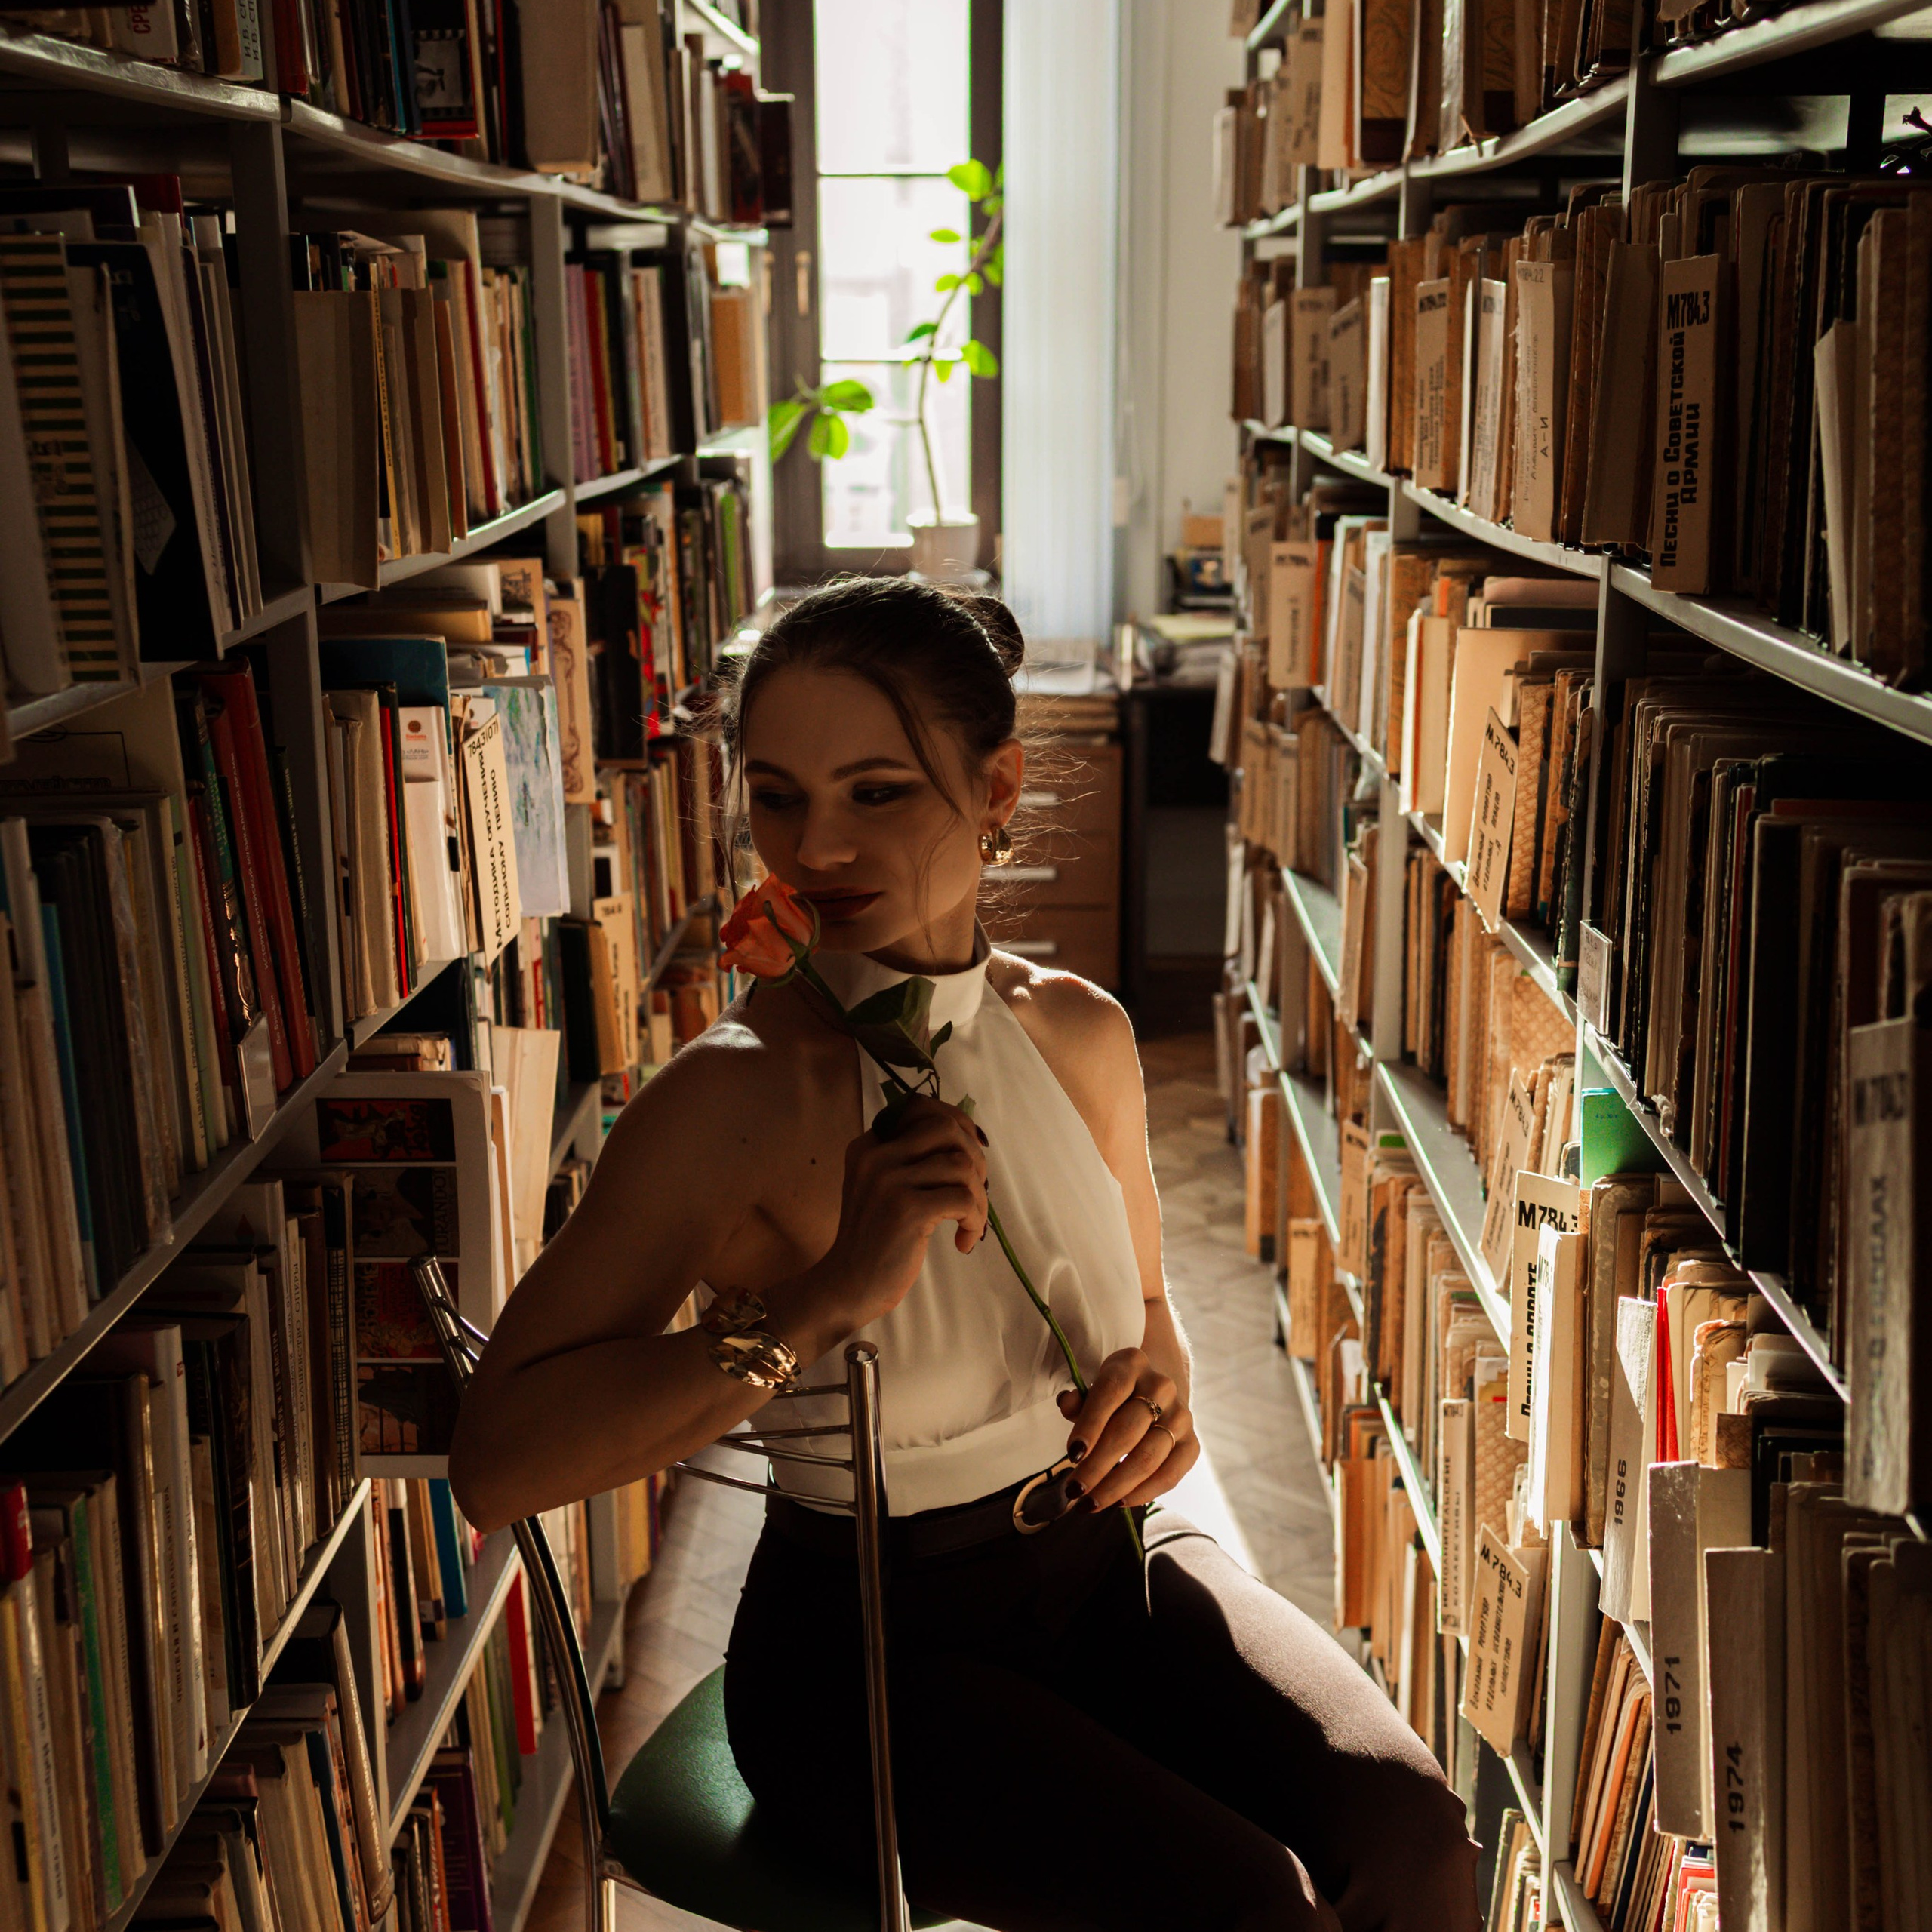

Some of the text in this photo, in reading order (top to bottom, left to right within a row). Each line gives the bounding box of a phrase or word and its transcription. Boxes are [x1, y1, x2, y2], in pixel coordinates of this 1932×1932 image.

[1667, 290, 1710, 330] М784.3
[478, 750, 503, 950] МЕТОДИКА ОБУЧЕНИЯ
[490, 768, 512, 929] СОЛЬНОМУ ПЕНИЮ
[1614, 1459, 1627, 1526] 1966
[1664, 1656, 1682, 1736] 1971
[1727, 1741, 1747, 1833] 1974
